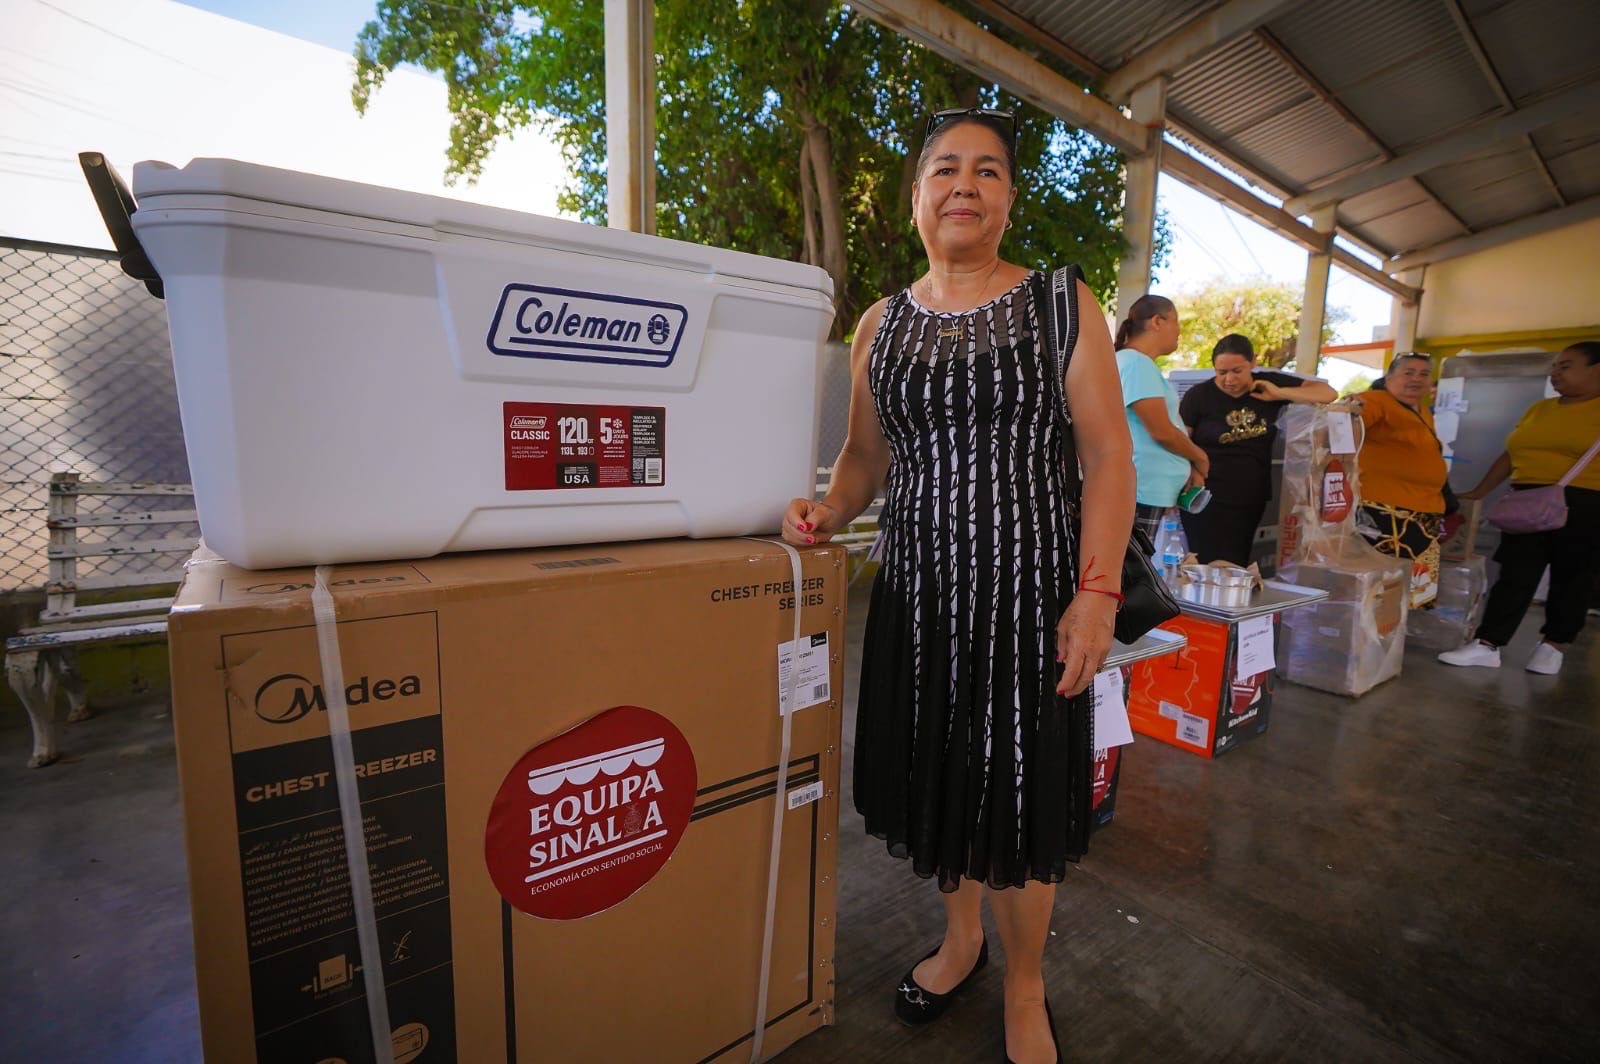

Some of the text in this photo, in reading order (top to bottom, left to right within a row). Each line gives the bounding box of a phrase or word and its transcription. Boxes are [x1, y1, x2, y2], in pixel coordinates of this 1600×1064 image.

[515, 296, 642, 343] Coleman
[510, 430, 551, 441] CLASSIC
[557, 416, 588, 444] 120
[600, 417, 613, 445] 5
[564, 475, 590, 485] USA
[246, 576, 406, 595] Mdea
[710, 584, 760, 603] CHEST
[778, 593, 824, 611] SEIES
[254, 673, 422, 725] Mdea
[246, 748, 438, 803] CHEST REEZER
[529, 768, 665, 836] EQUIPA
[530, 842, 665, 896] ECONOMÍA CON SENTIDO SOCIAL
